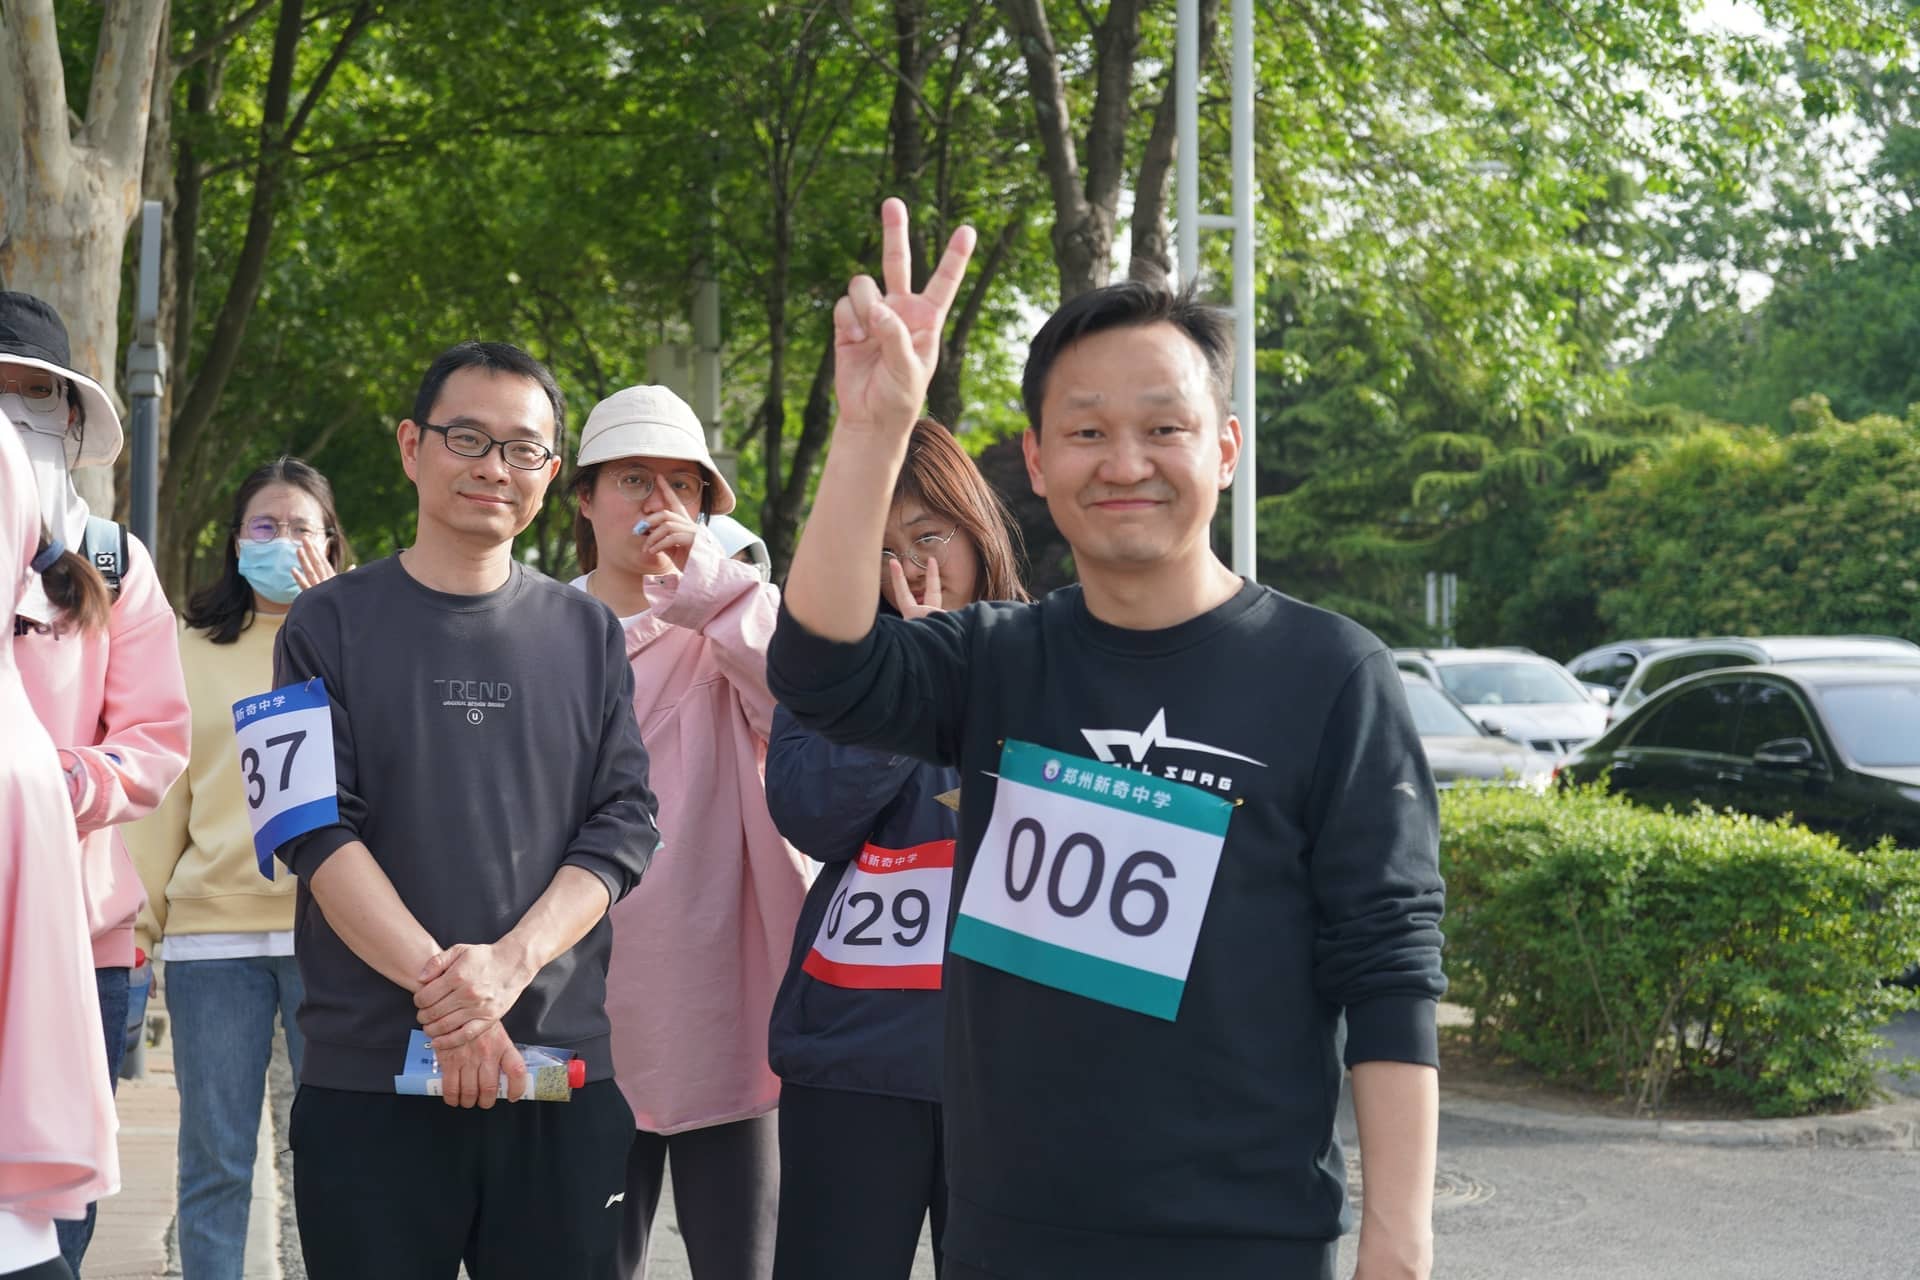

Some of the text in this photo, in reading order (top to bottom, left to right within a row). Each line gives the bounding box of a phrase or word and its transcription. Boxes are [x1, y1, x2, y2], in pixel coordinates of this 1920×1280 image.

[235, 695, 286, 722] 新奇中学
[433, 679, 512, 702] TREND
[240, 729, 307, 809] 37
[1061, 766, 1173, 809] 郑州新奇中学
[1163, 765, 1233, 792] SWAG
[1004, 817, 1177, 937] 006
[827, 885, 931, 947] 029
